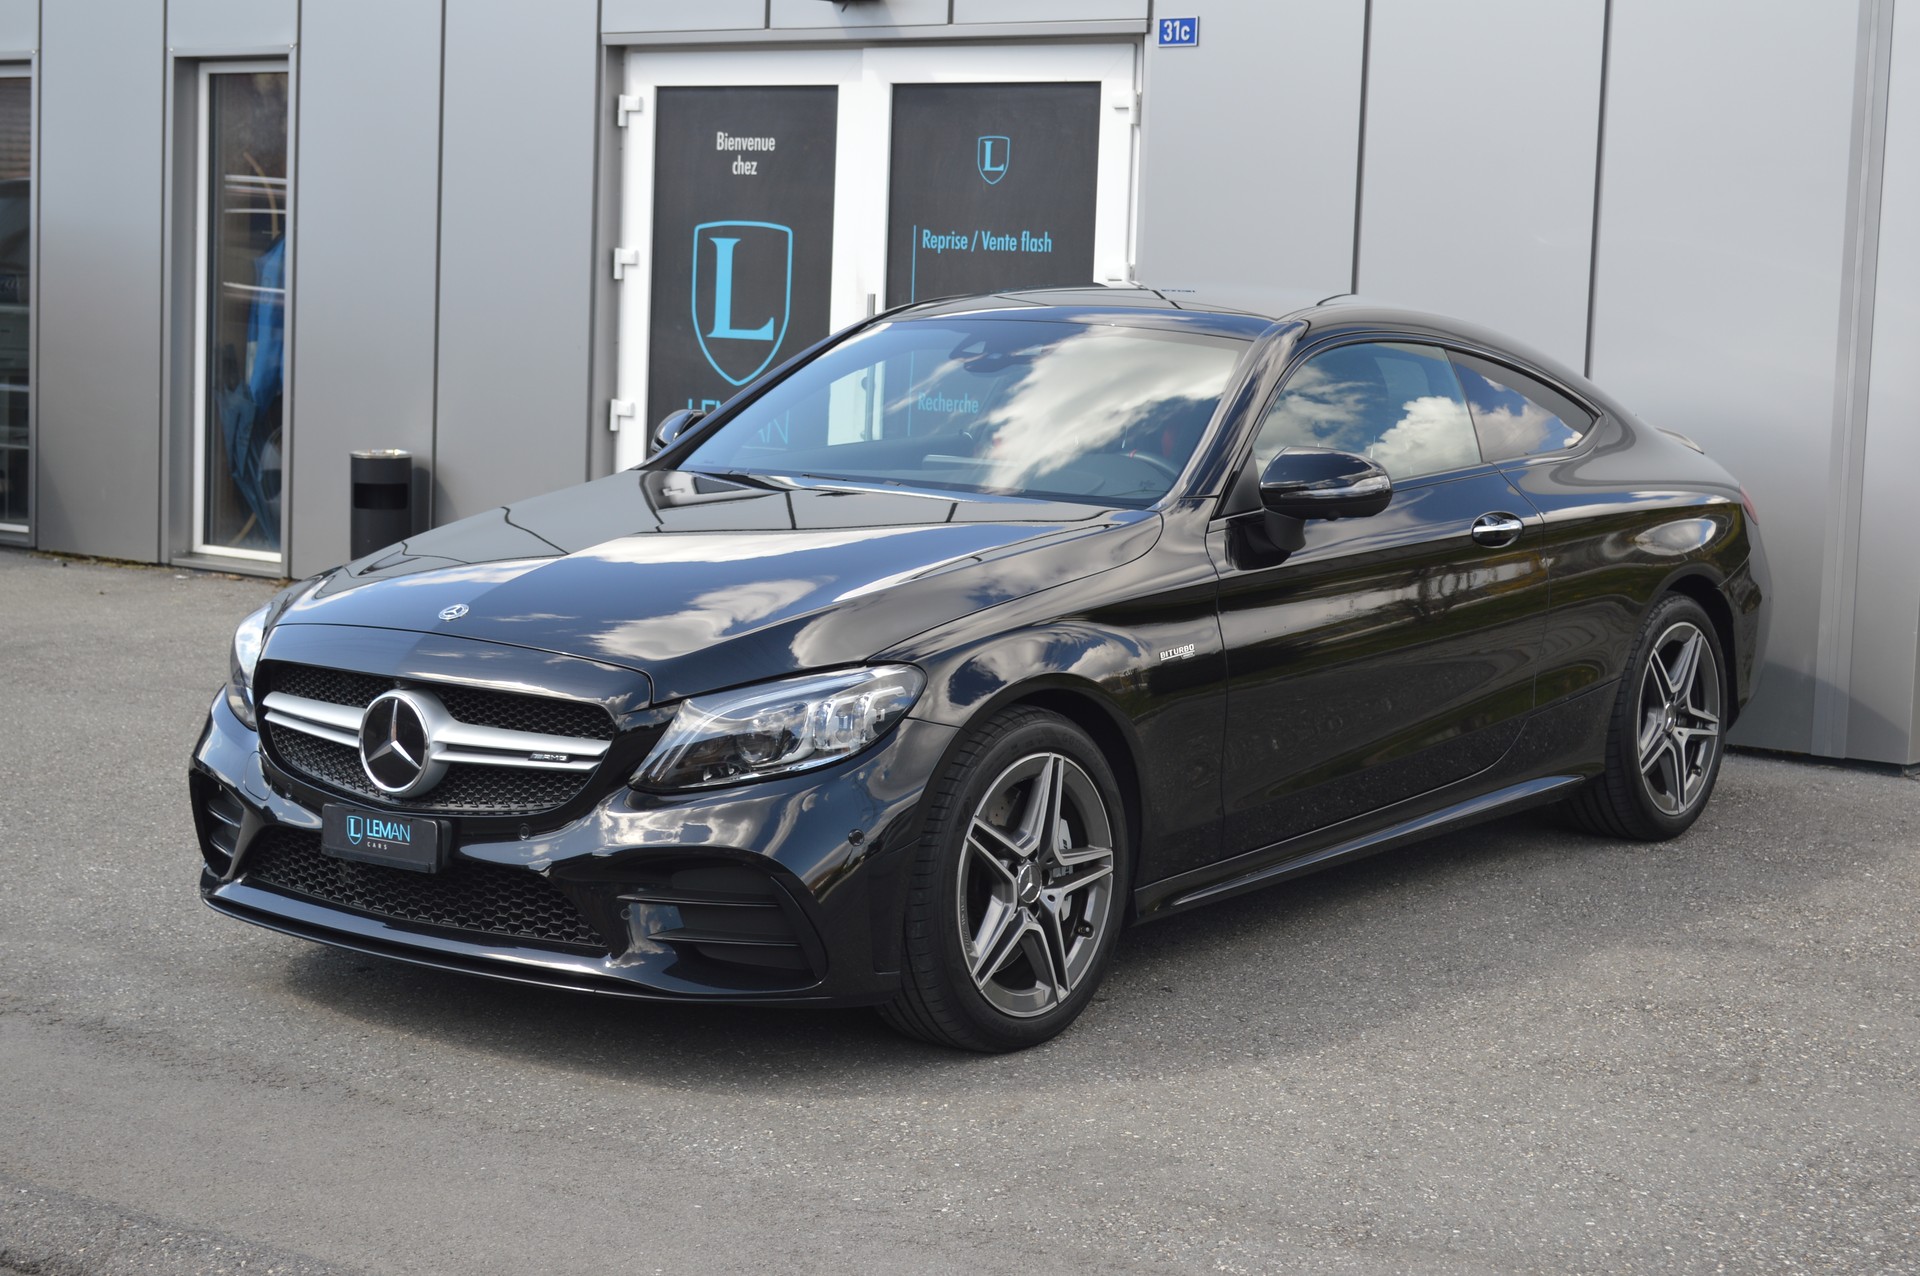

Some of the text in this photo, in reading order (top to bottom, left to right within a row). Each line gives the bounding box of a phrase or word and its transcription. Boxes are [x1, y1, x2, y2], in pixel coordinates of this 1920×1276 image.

[1163, 20, 1191, 42] 31c
[716, 131, 776, 152] Bienvenue
[732, 154, 758, 175] chez
[982, 140, 1005, 172] L
[922, 229, 968, 254] Reprise
[981, 231, 1018, 252] Vente
[1020, 230, 1053, 253] flash
[705, 236, 775, 341] L
[918, 391, 979, 414] Recherche
[1159, 643, 1196, 660] BITURBO
[366, 818, 411, 843] LEMAN
[366, 841, 388, 851] CARS
